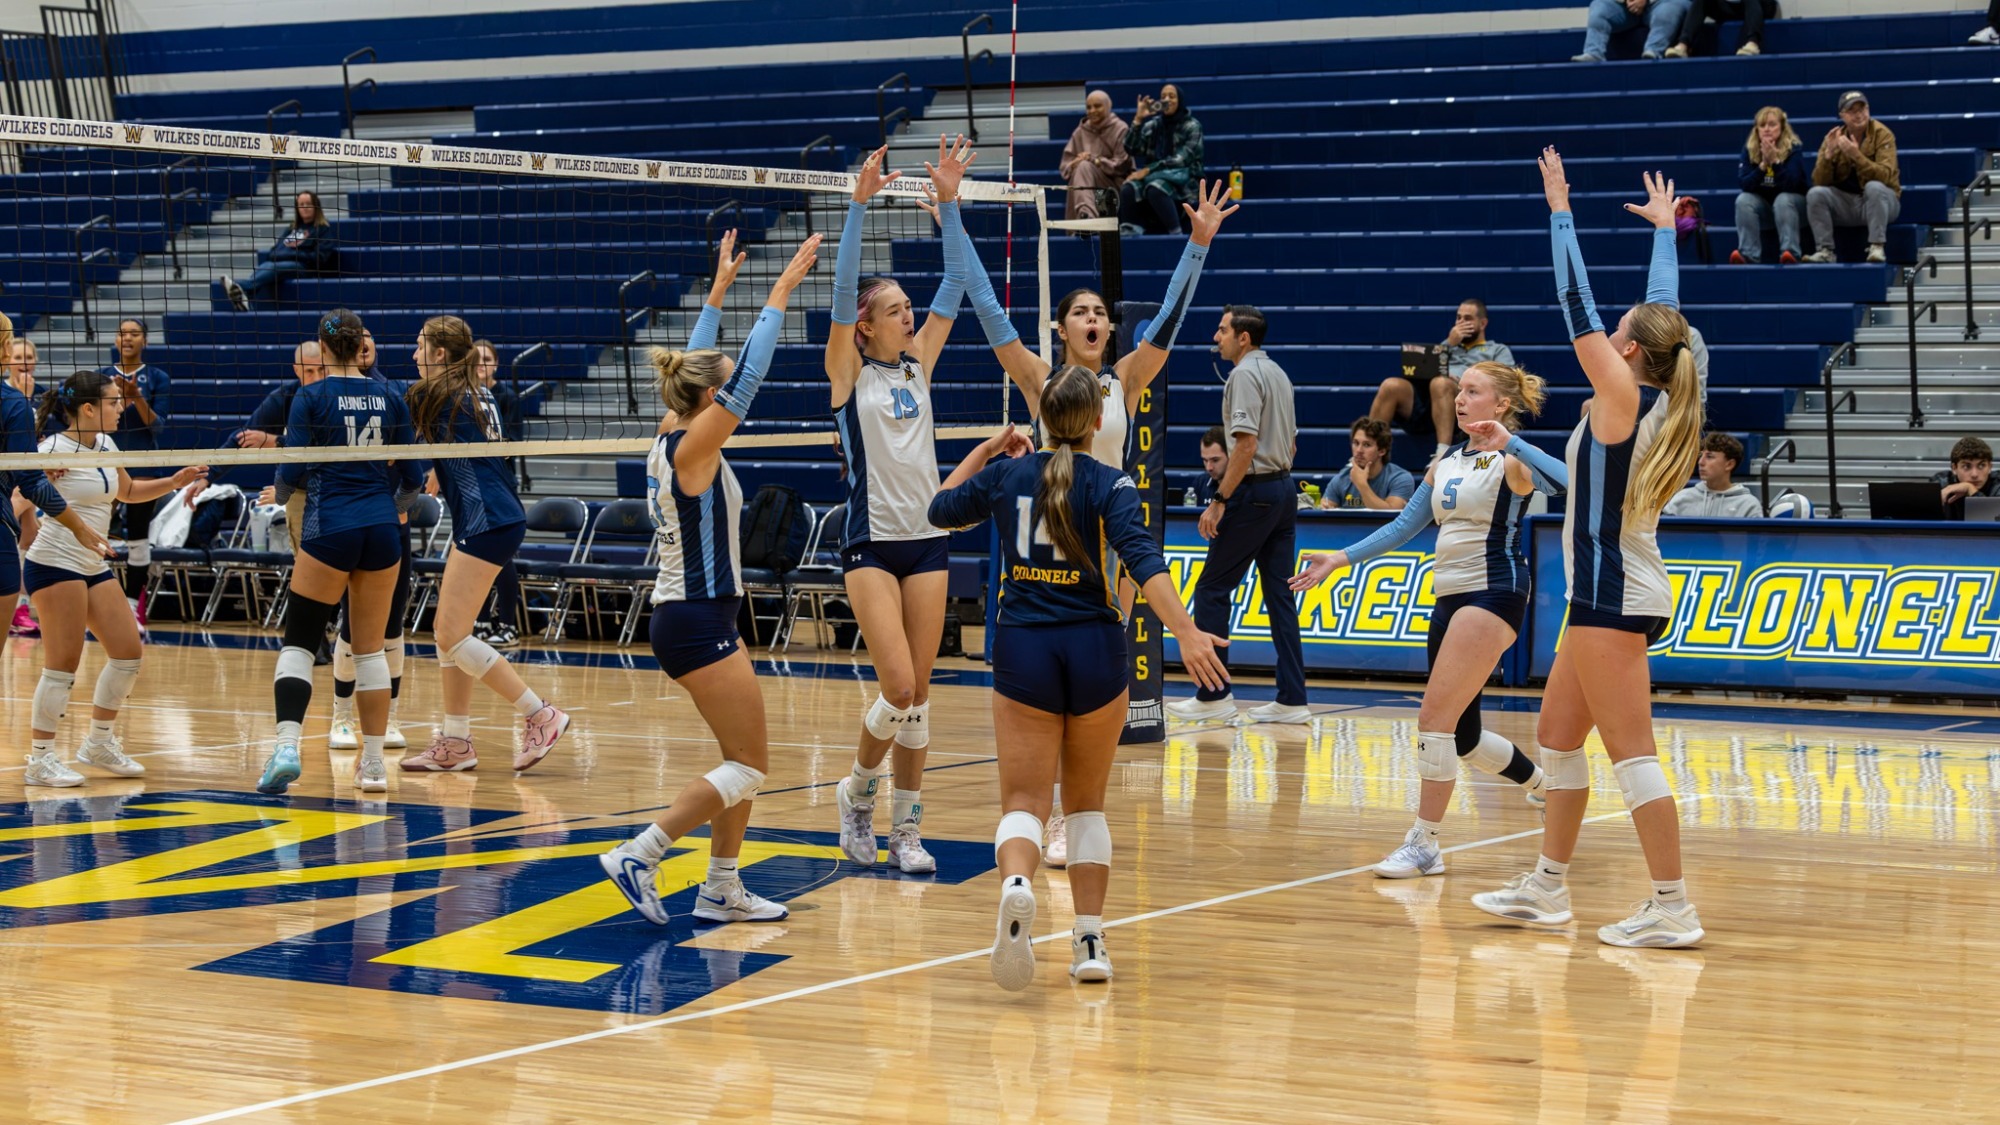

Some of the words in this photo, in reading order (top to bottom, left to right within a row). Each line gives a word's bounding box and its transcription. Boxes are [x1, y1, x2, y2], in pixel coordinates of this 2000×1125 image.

[0, 119, 46, 135] WILKES
[50, 122, 114, 139] COLONELS
[154, 129, 200, 145] WILKES
[203, 134, 261, 150] COLONELS
[298, 140, 341, 156] WILKES
[343, 144, 398, 160] COLONELS
[431, 149, 471, 163] WILKES
[473, 152, 523, 167] COLONELS
[554, 157, 591, 172] WILKES
[593, 160, 640, 175] COLONELS
[668, 165, 702, 178] WILKES
[704, 168, 748, 181] COLONELS
[774, 171, 806, 185] WILKES
[808, 173, 849, 187] COLONELS
[338, 395, 386, 411] ABINGTON
[890, 387, 919, 420] 19
[344, 415, 384, 447] 14
[1441, 477, 1464, 510] 5
[1012, 565, 1080, 585] COLONELS
[1650, 563, 2000, 660] OLONEL
